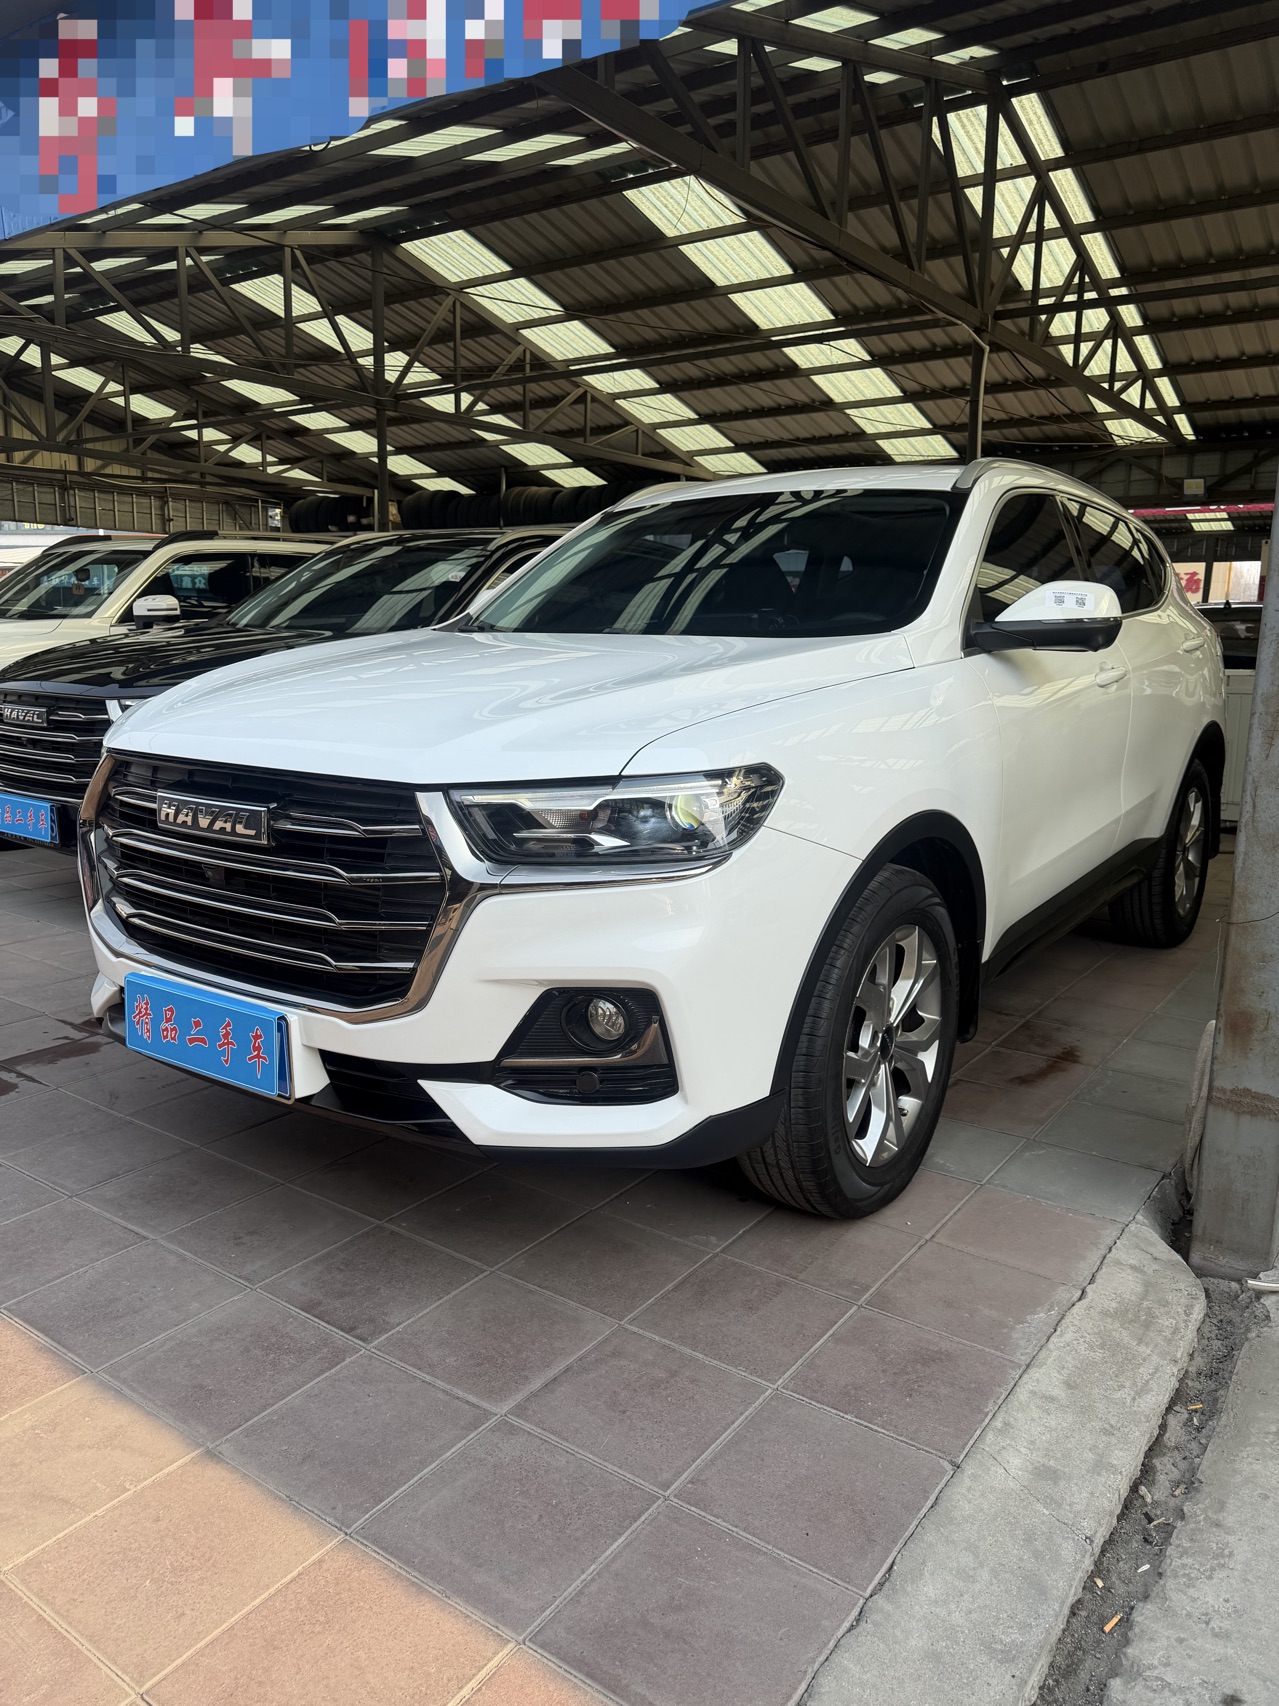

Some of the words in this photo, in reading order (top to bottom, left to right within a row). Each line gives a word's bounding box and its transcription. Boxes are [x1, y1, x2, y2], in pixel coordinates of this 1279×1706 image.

[4, 708, 42, 722] HAVAL
[0, 804, 47, 835] 品二手车
[160, 800, 257, 836] HAVAL
[131, 994, 269, 1079] 精品二手车
